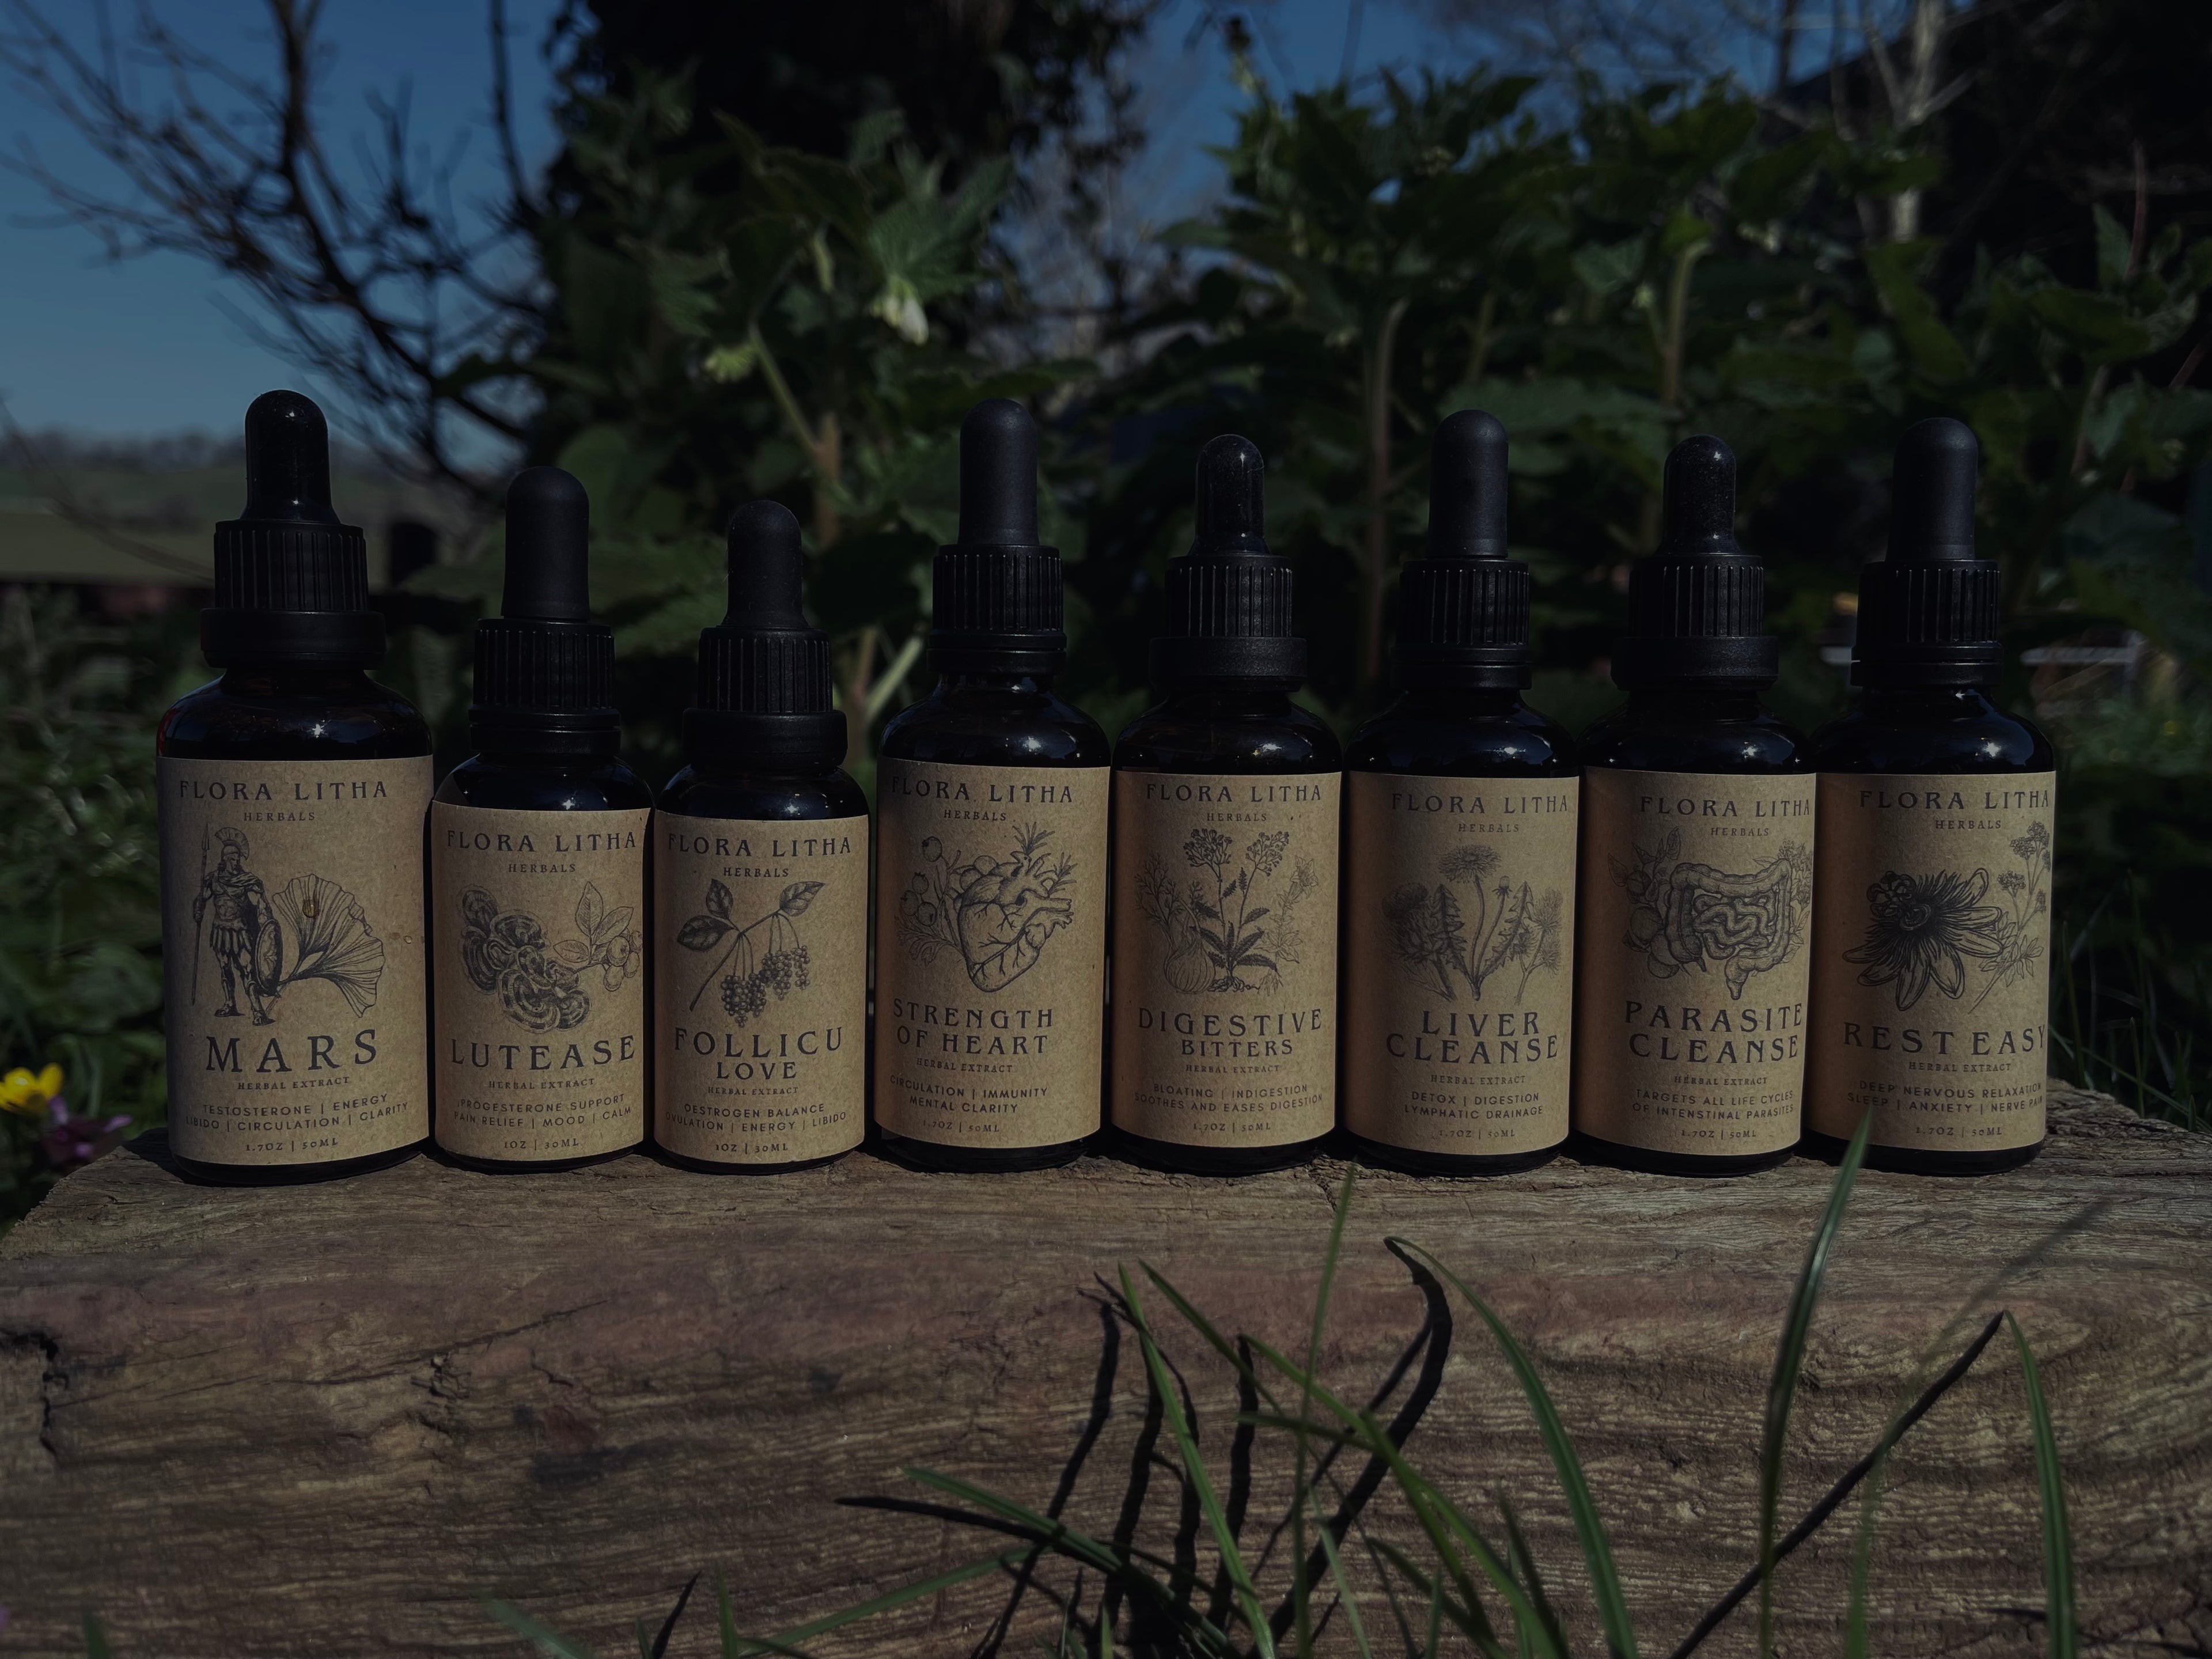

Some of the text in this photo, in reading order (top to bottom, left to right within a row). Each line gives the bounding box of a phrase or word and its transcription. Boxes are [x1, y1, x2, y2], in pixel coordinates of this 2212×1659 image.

[180, 781, 387, 800] FLORA LITHA
[892, 776, 1073, 803] FLORA LITHA
[1147, 784, 1321, 802] FLORA LITHA
[1392, 793, 1567, 814] FLORA LITHA
[1641, 796, 1810, 817] FLORA LITHA
[1860, 790, 2048, 809] FLORA LITHA
[244, 812, 316, 821] HERBALS
[944, 809, 1006, 821] HERBALS
[1207, 813, 1267, 821] HERBALS
[1459, 824, 1519, 832] HERBALS
[1711, 828, 1769, 836] HERBALS
[1935, 820, 2001, 829] HERBALS
[447, 830, 636, 852] FLORA LITHA
[669, 834, 851, 857] FLORA LITHA
[509, 864, 576, 873] HERBALS
[724, 867, 789, 877] HERBALS
[893, 998, 1052, 1029] STRENGTH
[1138, 1008, 1321, 1036] DIGESTIVE
[1625, 1001, 1802, 1032] PARASITE
[1422, 1010, 1539, 1037] LIVER
[675, 1027, 842, 1058] FOLLICU
[897, 1025, 1048, 1055] OF HEART
[1844, 1022, 2045, 1055] REST EASY
[206, 1029, 377, 1073] MARS
[451, 1036, 635, 1070] LUTEASE
[1181, 1039, 1293, 1057] BITTERS
[1386, 1033, 1557, 1064] CLEANSE
[1630, 1033, 1798, 1063] CLEANSE
[717, 1062, 797, 1080] LOVE
[916, 1058, 1012, 1073] HERBAL EXTRACT
[1186, 1064, 1280, 1073] HERBAL EXTRACT
[1909, 1062, 2011, 1072] HERBAL EXTRACT
[237, 1077, 350, 1090] HERBAL EXTRACT
[489, 1078, 594, 1089] HERBAL EXTRACT
[890, 1075, 1047, 1098] CIRCULATION IMMUNITY
[1431, 1075, 1525, 1084] HERBAL EXTRACT
[1675, 1076, 1767, 1085] HERBAL EXTRACT
[708, 1087, 798, 1095] HERBAL EXTRACT
[1154, 1084, 1307, 1099] BLOATING INDIGESTION
[1636, 1089, 1793, 1105] TARGETS ALL LIFE CYCLES
[1859, 1080, 2041, 1098] DEEP NERVOUS RELAXATION
[203, 1094, 387, 1116] TESTOSTERONE ENERGY
[460, 1094, 624, 1112] PROGESTERONE SUPPORT
[910, 1097, 1017, 1113] MENTAL CLARITY
[1135, 1093, 1322, 1112] SOOTHES AND EASES DIGESTION
[1412, 1092, 1539, 1105] DETOX DIGESTION
[1847, 1093, 1888, 1106] SLEEP
[1910, 1102, 1971, 1112] ANXIETY
[1991, 1102, 2025, 1112] NERVE
[185, 1102, 408, 1131] LIBIDO CIRCULATION CLARITY
[454, 1107, 631, 1127] PAIN RELIEF MOOD CALM
[684, 1104, 824, 1118] OESTROGEN BALANCE
[1405, 1104, 1543, 1119] LYMPHATIC DRAINAGE
[1633, 1103, 1793, 1119] OF INTENSTINAL PARASITES
[666, 1112, 846, 1131] OVULATION ENERGY LIBIDO
